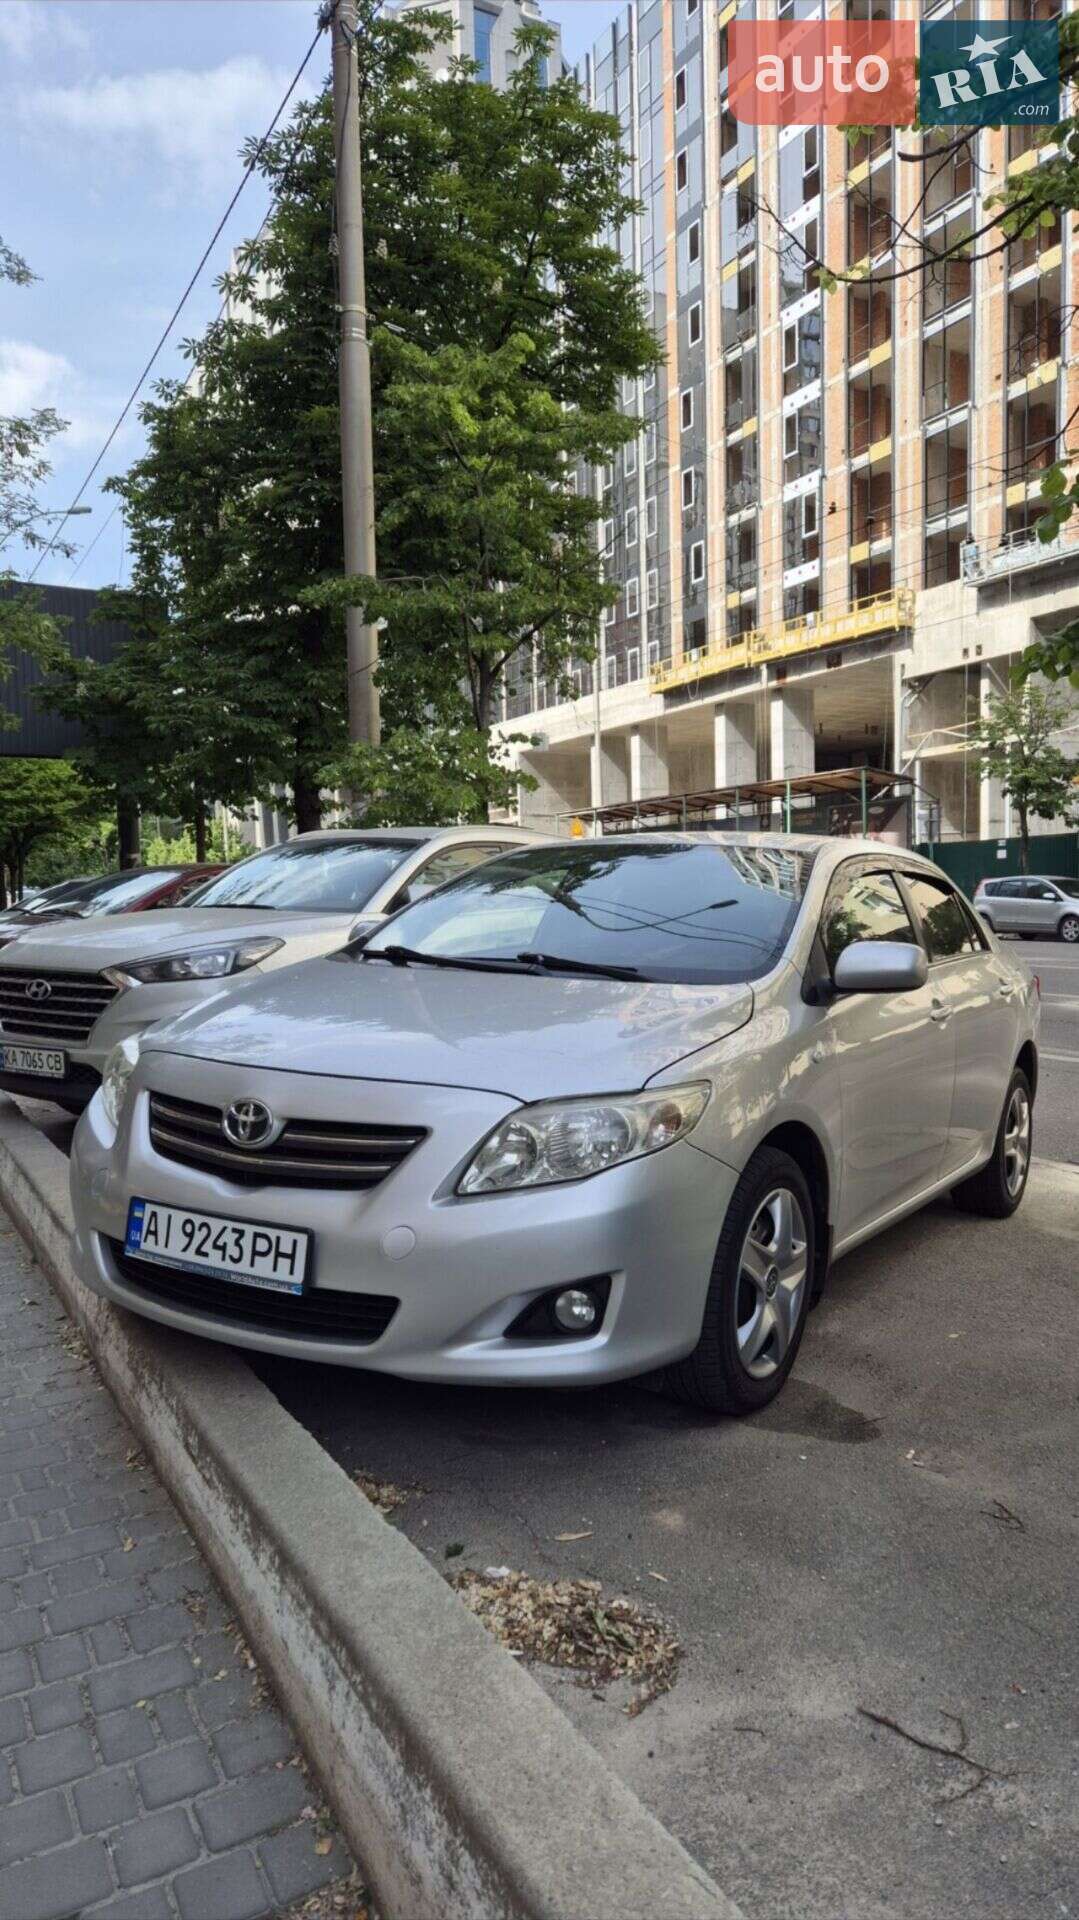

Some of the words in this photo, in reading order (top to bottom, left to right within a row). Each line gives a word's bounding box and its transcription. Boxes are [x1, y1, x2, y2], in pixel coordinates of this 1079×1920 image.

[20, 1050, 44, 1069] 7065
[46, 1053, 62, 1071] CB
[143, 1210, 172, 1249] AI
[180, 1218, 246, 1264] 9243
[249, 1231, 298, 1276] PH
